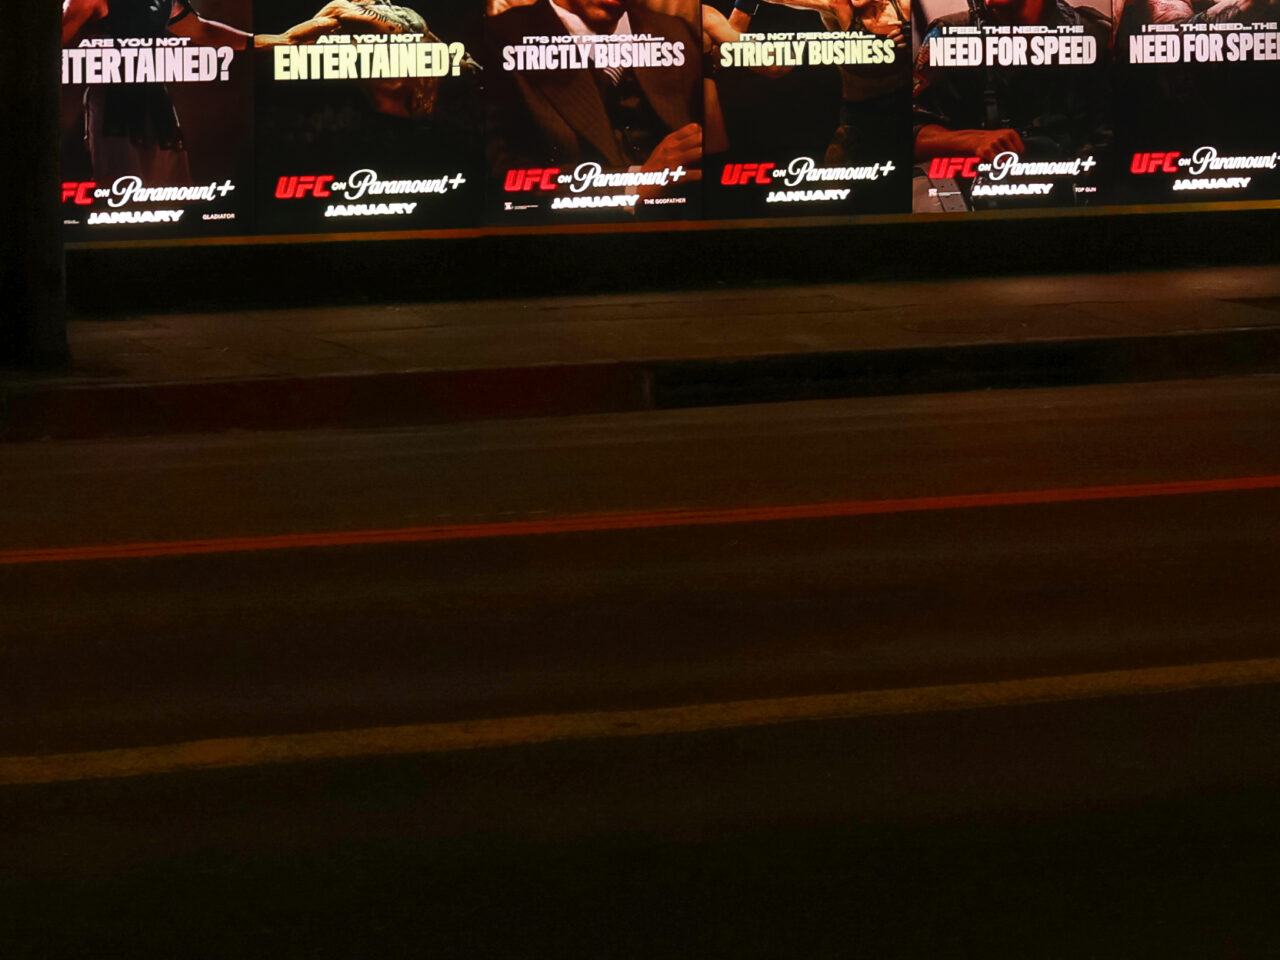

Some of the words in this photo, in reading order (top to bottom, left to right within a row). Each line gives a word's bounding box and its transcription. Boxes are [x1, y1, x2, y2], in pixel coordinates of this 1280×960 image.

[768, 33, 795, 41] NOT
[942, 27, 947, 35] I
[983, 26, 1010, 34] THE
[1148, 24, 1179, 32] FEEL
[79, 39, 114, 48] ARE
[117, 38, 153, 47] YOU
[156, 38, 191, 46] NOT
[316, 35, 351, 44] ARE
[354, 35, 388, 43] YOU
[391, 34, 424, 43] NOT
[523, 36, 550, 44] IT'S
[551, 35, 580, 44] NOT
[503, 44, 592, 71] STRICTLY
[595, 42, 685, 69] BUSINESS
[720, 41, 806, 68] STRICTLY
[809, 39, 896, 65] BUSINESS
[930, 37, 983, 67] NEED
[986, 37, 1028, 66] FOR
[1031, 36, 1097, 65] SPEED
[1130, 34, 1180, 64] NEED
[1184, 34, 1223, 63] FOR
[62, 46, 234, 84] TERTAINED?
[274, 42, 465, 80] ENTERTAINED?
[721, 163, 775, 185] UFC
[773, 170, 786, 178] ON
[784, 157, 896, 187] Paramount+
[929, 157, 981, 179] UFC
[978, 164, 992, 172] ON
[989, 151, 1097, 181] Paramount+
[1130, 152, 1180, 174] UFC
[1178, 159, 1191, 167] ON
[275, 175, 334, 199] UFC
[331, 182, 347, 191] ON
[344, 169, 466, 200] Paramount+
[504, 168, 560, 191] UFC
[558, 175, 572, 184] ON
[570, 162, 686, 193] Paramount+
[1173, 177, 1251, 190] JANUARY
[62, 182, 96, 205] FC
[94, 189, 109, 198] ON
[108, 176, 235, 208] Paramount+
[766, 189, 851, 203] JANUARY
[972, 183, 1054, 196] JANUARY
[325, 203, 417, 217] JANUARY
[551, 195, 640, 210] JANUARY
[88, 210, 184, 224] JANUARY
